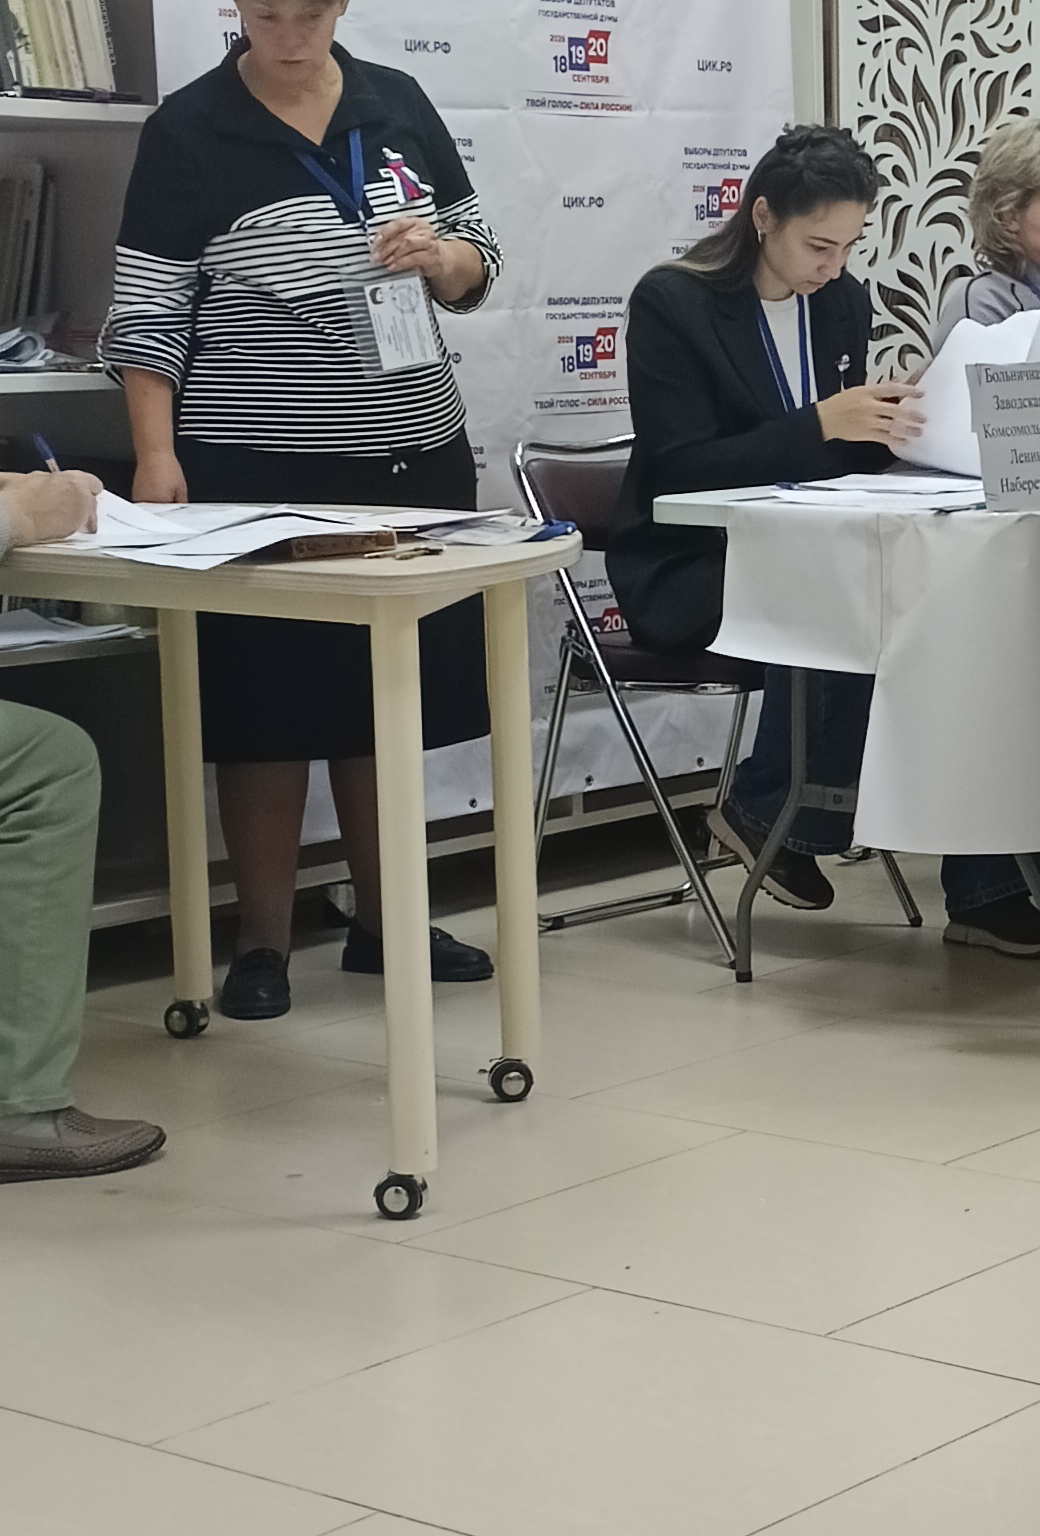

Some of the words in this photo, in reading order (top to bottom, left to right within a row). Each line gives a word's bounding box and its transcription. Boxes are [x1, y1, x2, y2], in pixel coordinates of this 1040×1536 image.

[404, 39, 451, 54] ЦИК.РФ
[553, 55, 567, 73] 18
[570, 45, 585, 64] 19
[588, 37, 606, 57] 20
[697, 58, 733, 73] ЦИК.РФ
[563, 196, 604, 208] ЦИК.РФ
[694, 204, 705, 221] 18
[708, 193, 720, 212] 19
[721, 185, 739, 204] 20
[560, 355, 575, 373] 18
[578, 344, 593, 362] 19
[596, 335, 614, 353] 20
[608, 397, 629, 406] РОСС
[603, 614, 622, 632] 20
